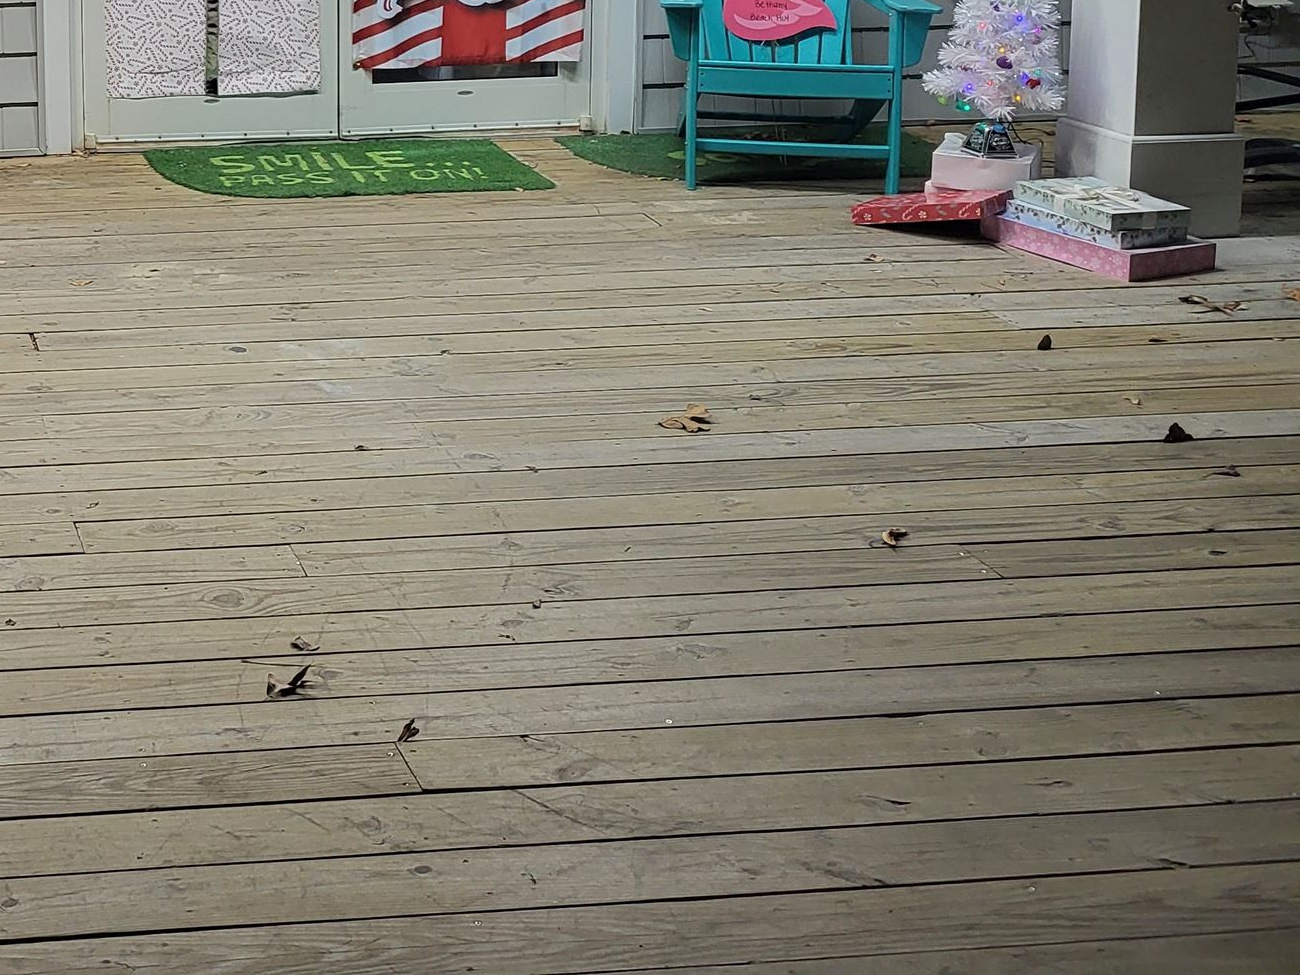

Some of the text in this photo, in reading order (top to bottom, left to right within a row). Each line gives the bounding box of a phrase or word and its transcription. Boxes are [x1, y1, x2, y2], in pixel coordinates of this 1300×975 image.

[755, 0, 788, 10] Bethany
[219, 171, 335, 187] PASS
[351, 169, 392, 183] IT
